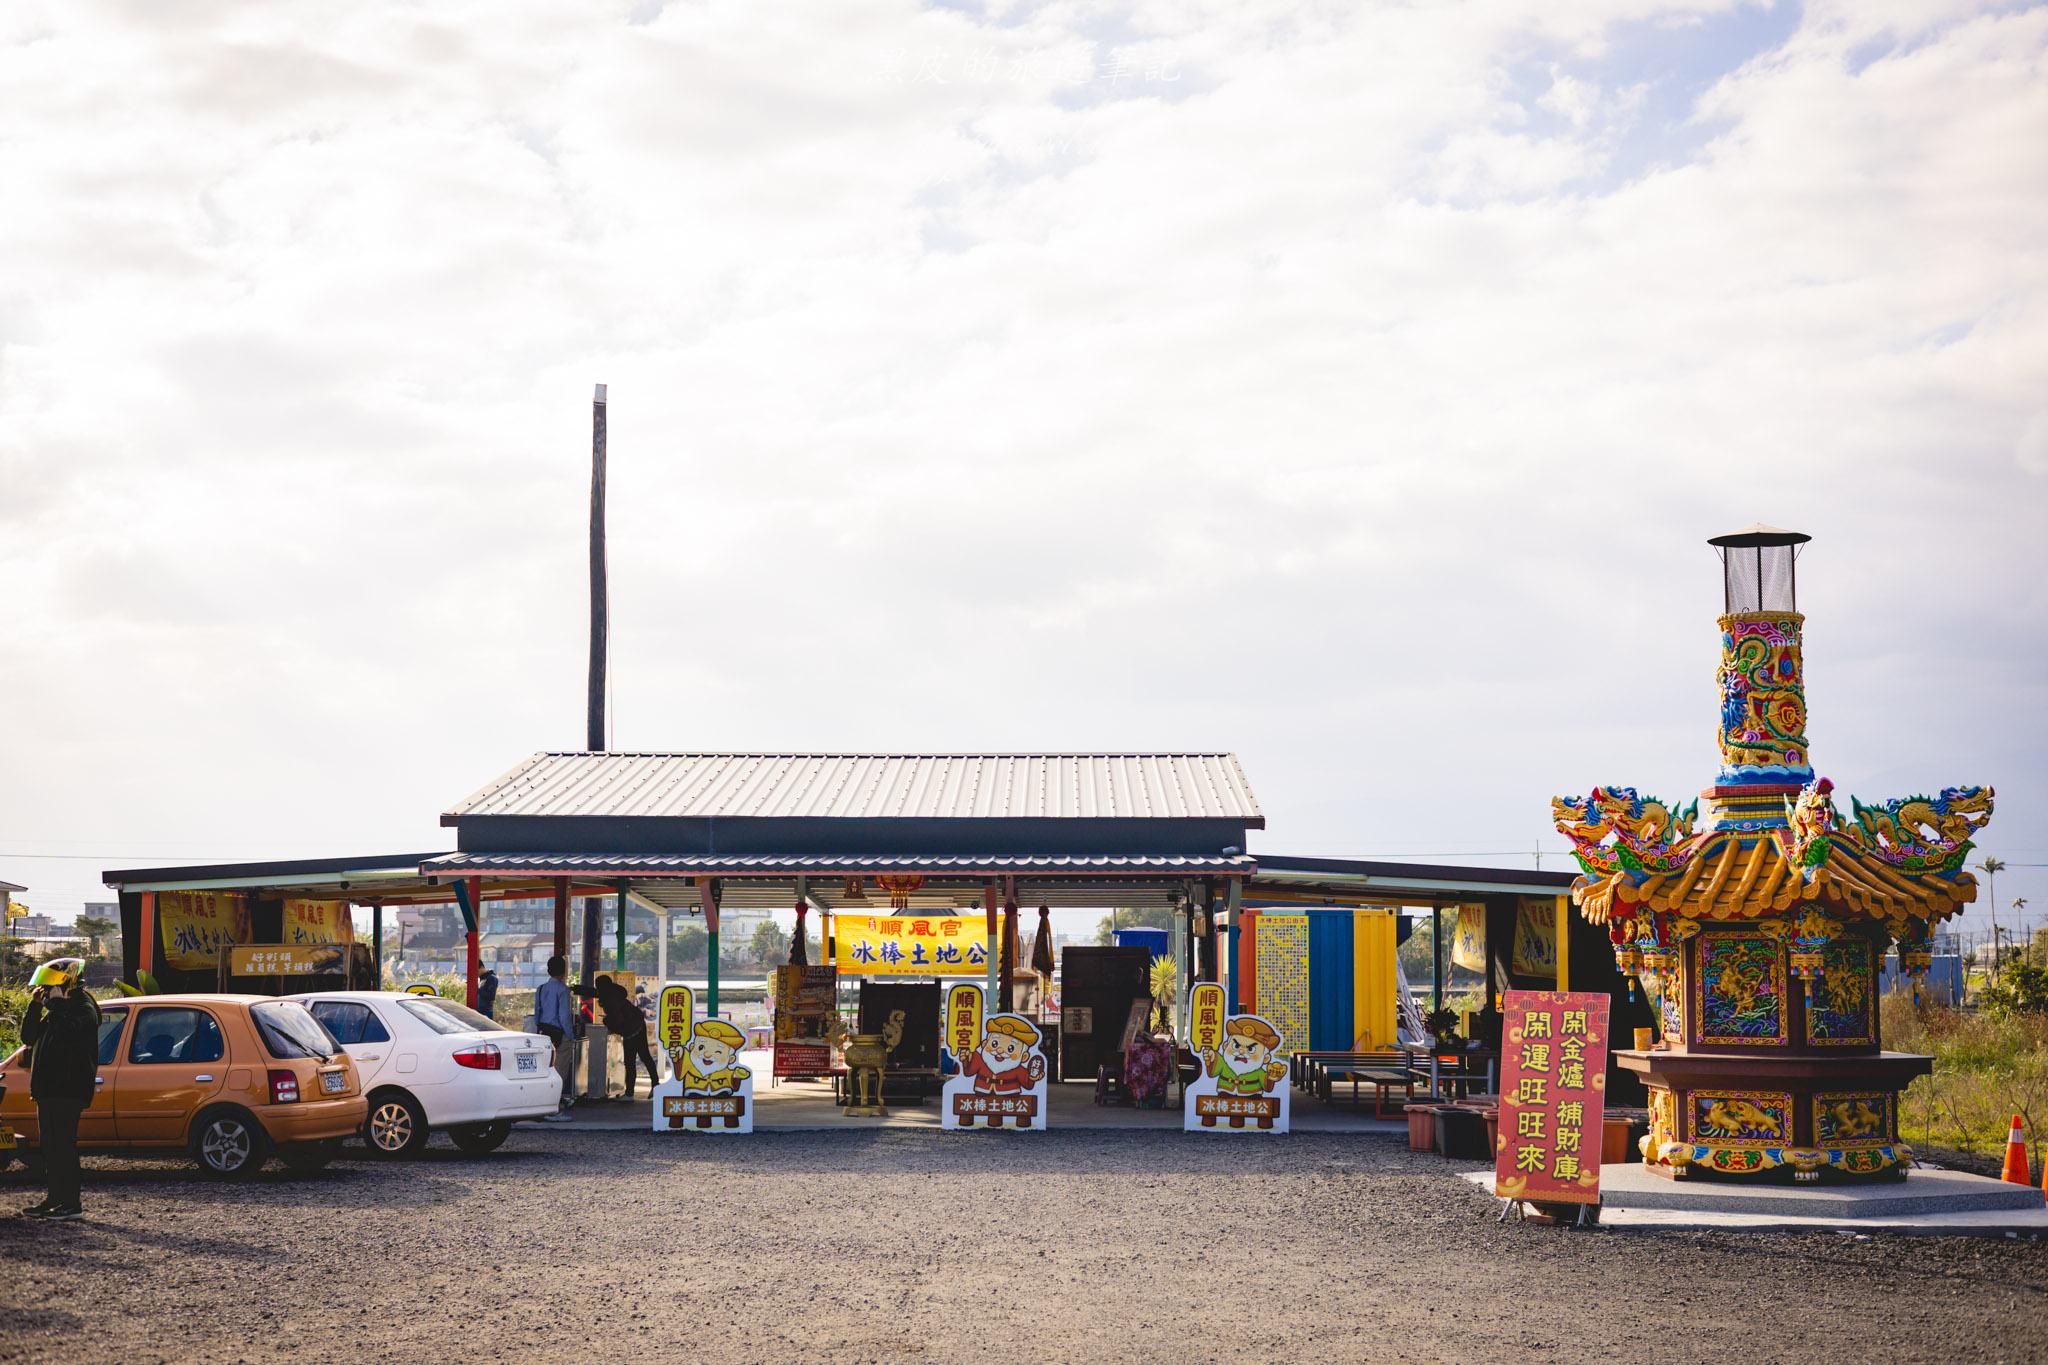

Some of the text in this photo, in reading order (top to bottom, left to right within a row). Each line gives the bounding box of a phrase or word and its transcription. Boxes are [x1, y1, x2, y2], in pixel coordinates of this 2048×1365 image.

[879, 919, 962, 938] 順風宮
[851, 940, 988, 966] 冰棒土地公
[666, 991, 685, 1040] 順風宮
[956, 991, 975, 1046] 順風宮
[1199, 990, 1219, 1045] 順風宮
[669, 1100, 735, 1113] 冰棒土地公
[959, 1099, 1029, 1113] 冰棒土地公
[1202, 1099, 1270, 1114] 冰棒土地公
[1516, 1011, 1552, 1173] 開運旺旺來
[1553, 1011, 1588, 1181] 開金爐 補財庫
